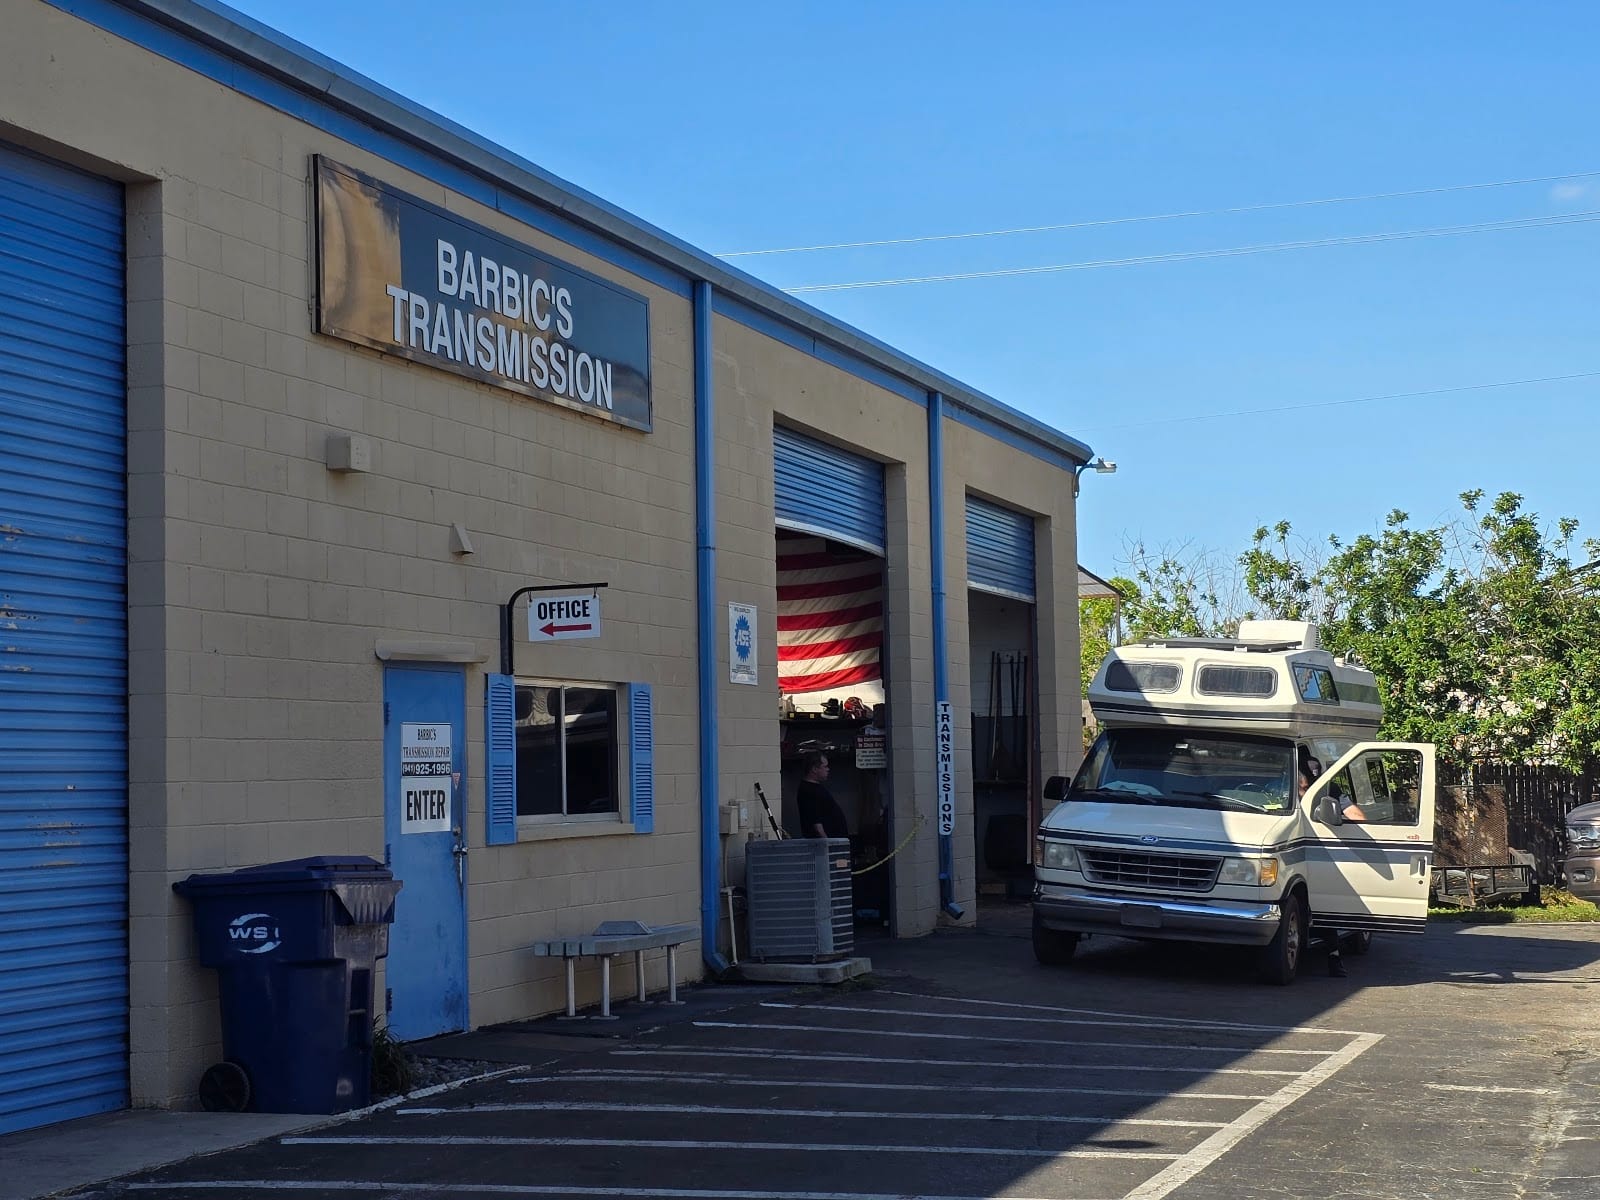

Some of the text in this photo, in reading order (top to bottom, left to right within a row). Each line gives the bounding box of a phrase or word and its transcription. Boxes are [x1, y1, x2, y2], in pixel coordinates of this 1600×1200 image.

[437, 239, 573, 340] BARBIC'S
[386, 284, 613, 410] TRANSMISSION
[537, 600, 590, 620] OFFICE
[403, 746, 434, 759] TRANSMISSION
[941, 703, 951, 832] TRANSMISSIONS
[415, 763, 451, 775] 925-1996
[406, 789, 446, 821] ENTER
